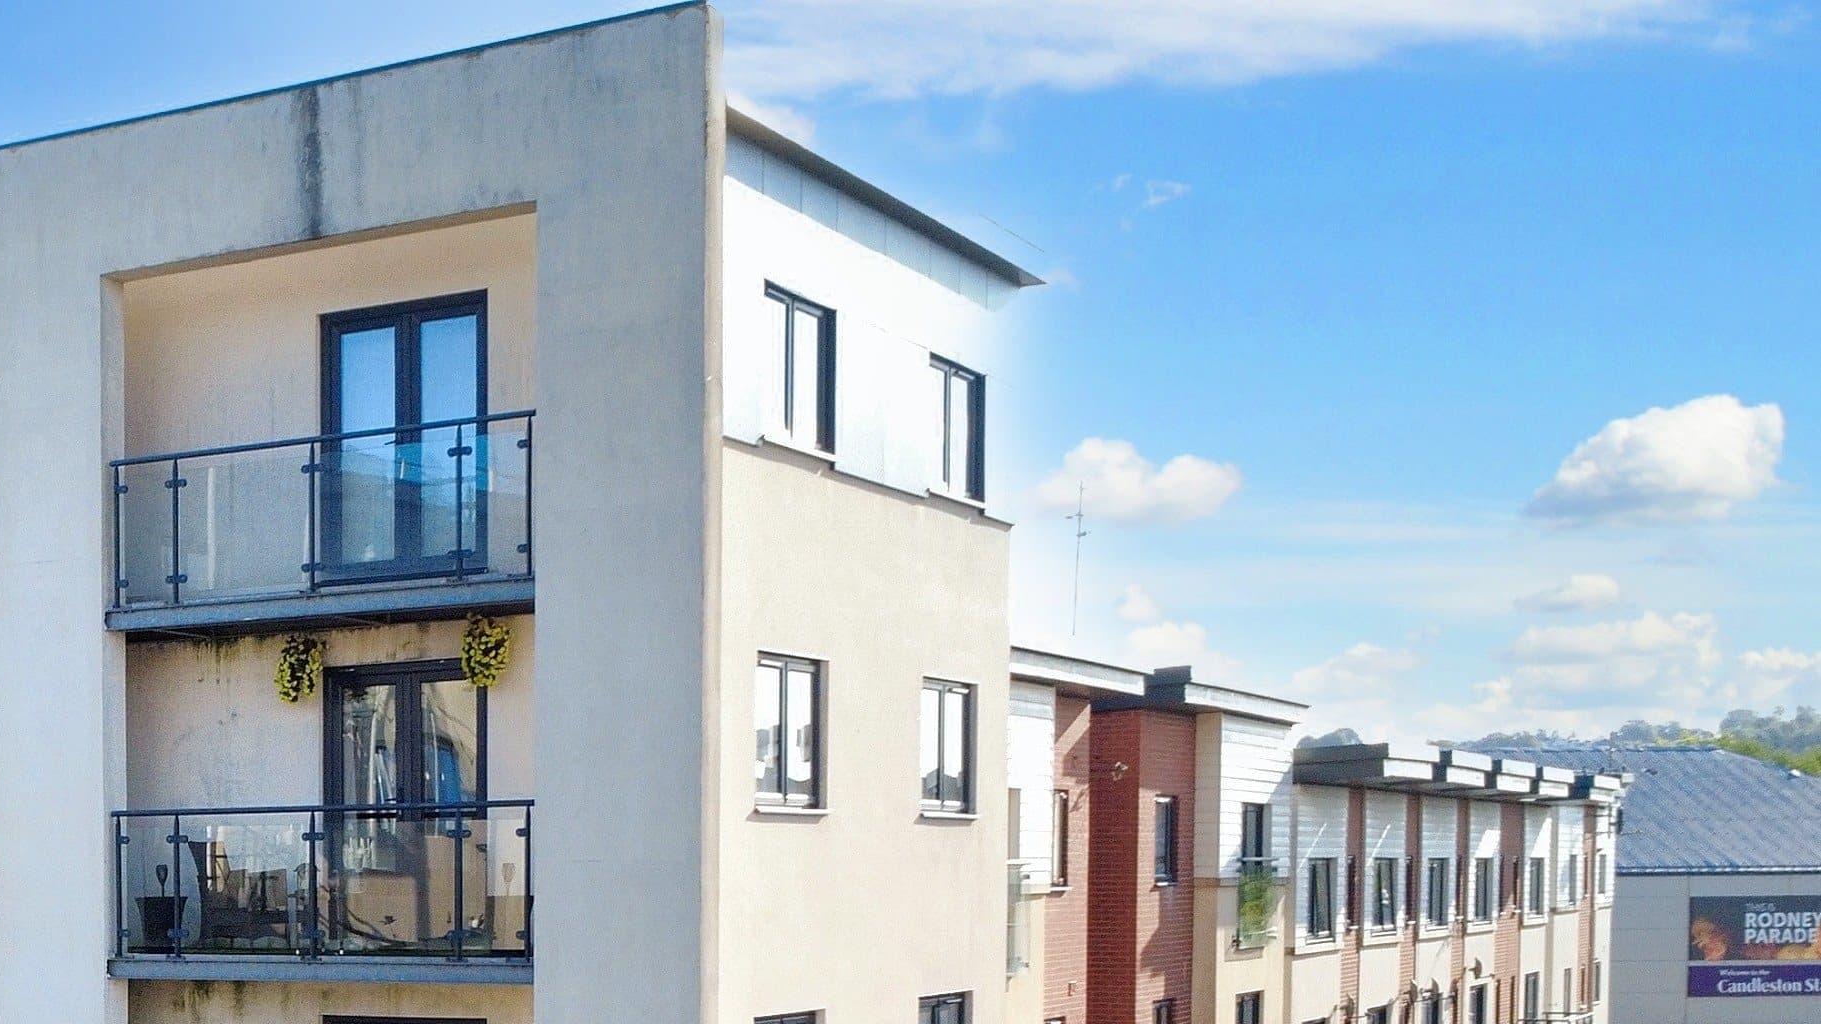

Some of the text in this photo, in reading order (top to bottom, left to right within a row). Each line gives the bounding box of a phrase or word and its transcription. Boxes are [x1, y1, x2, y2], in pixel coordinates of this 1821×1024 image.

[1745, 912, 1821, 928] RODNEY
[1745, 928, 1818, 944] PARADE
[1717, 977, 1802, 993] Candleston
